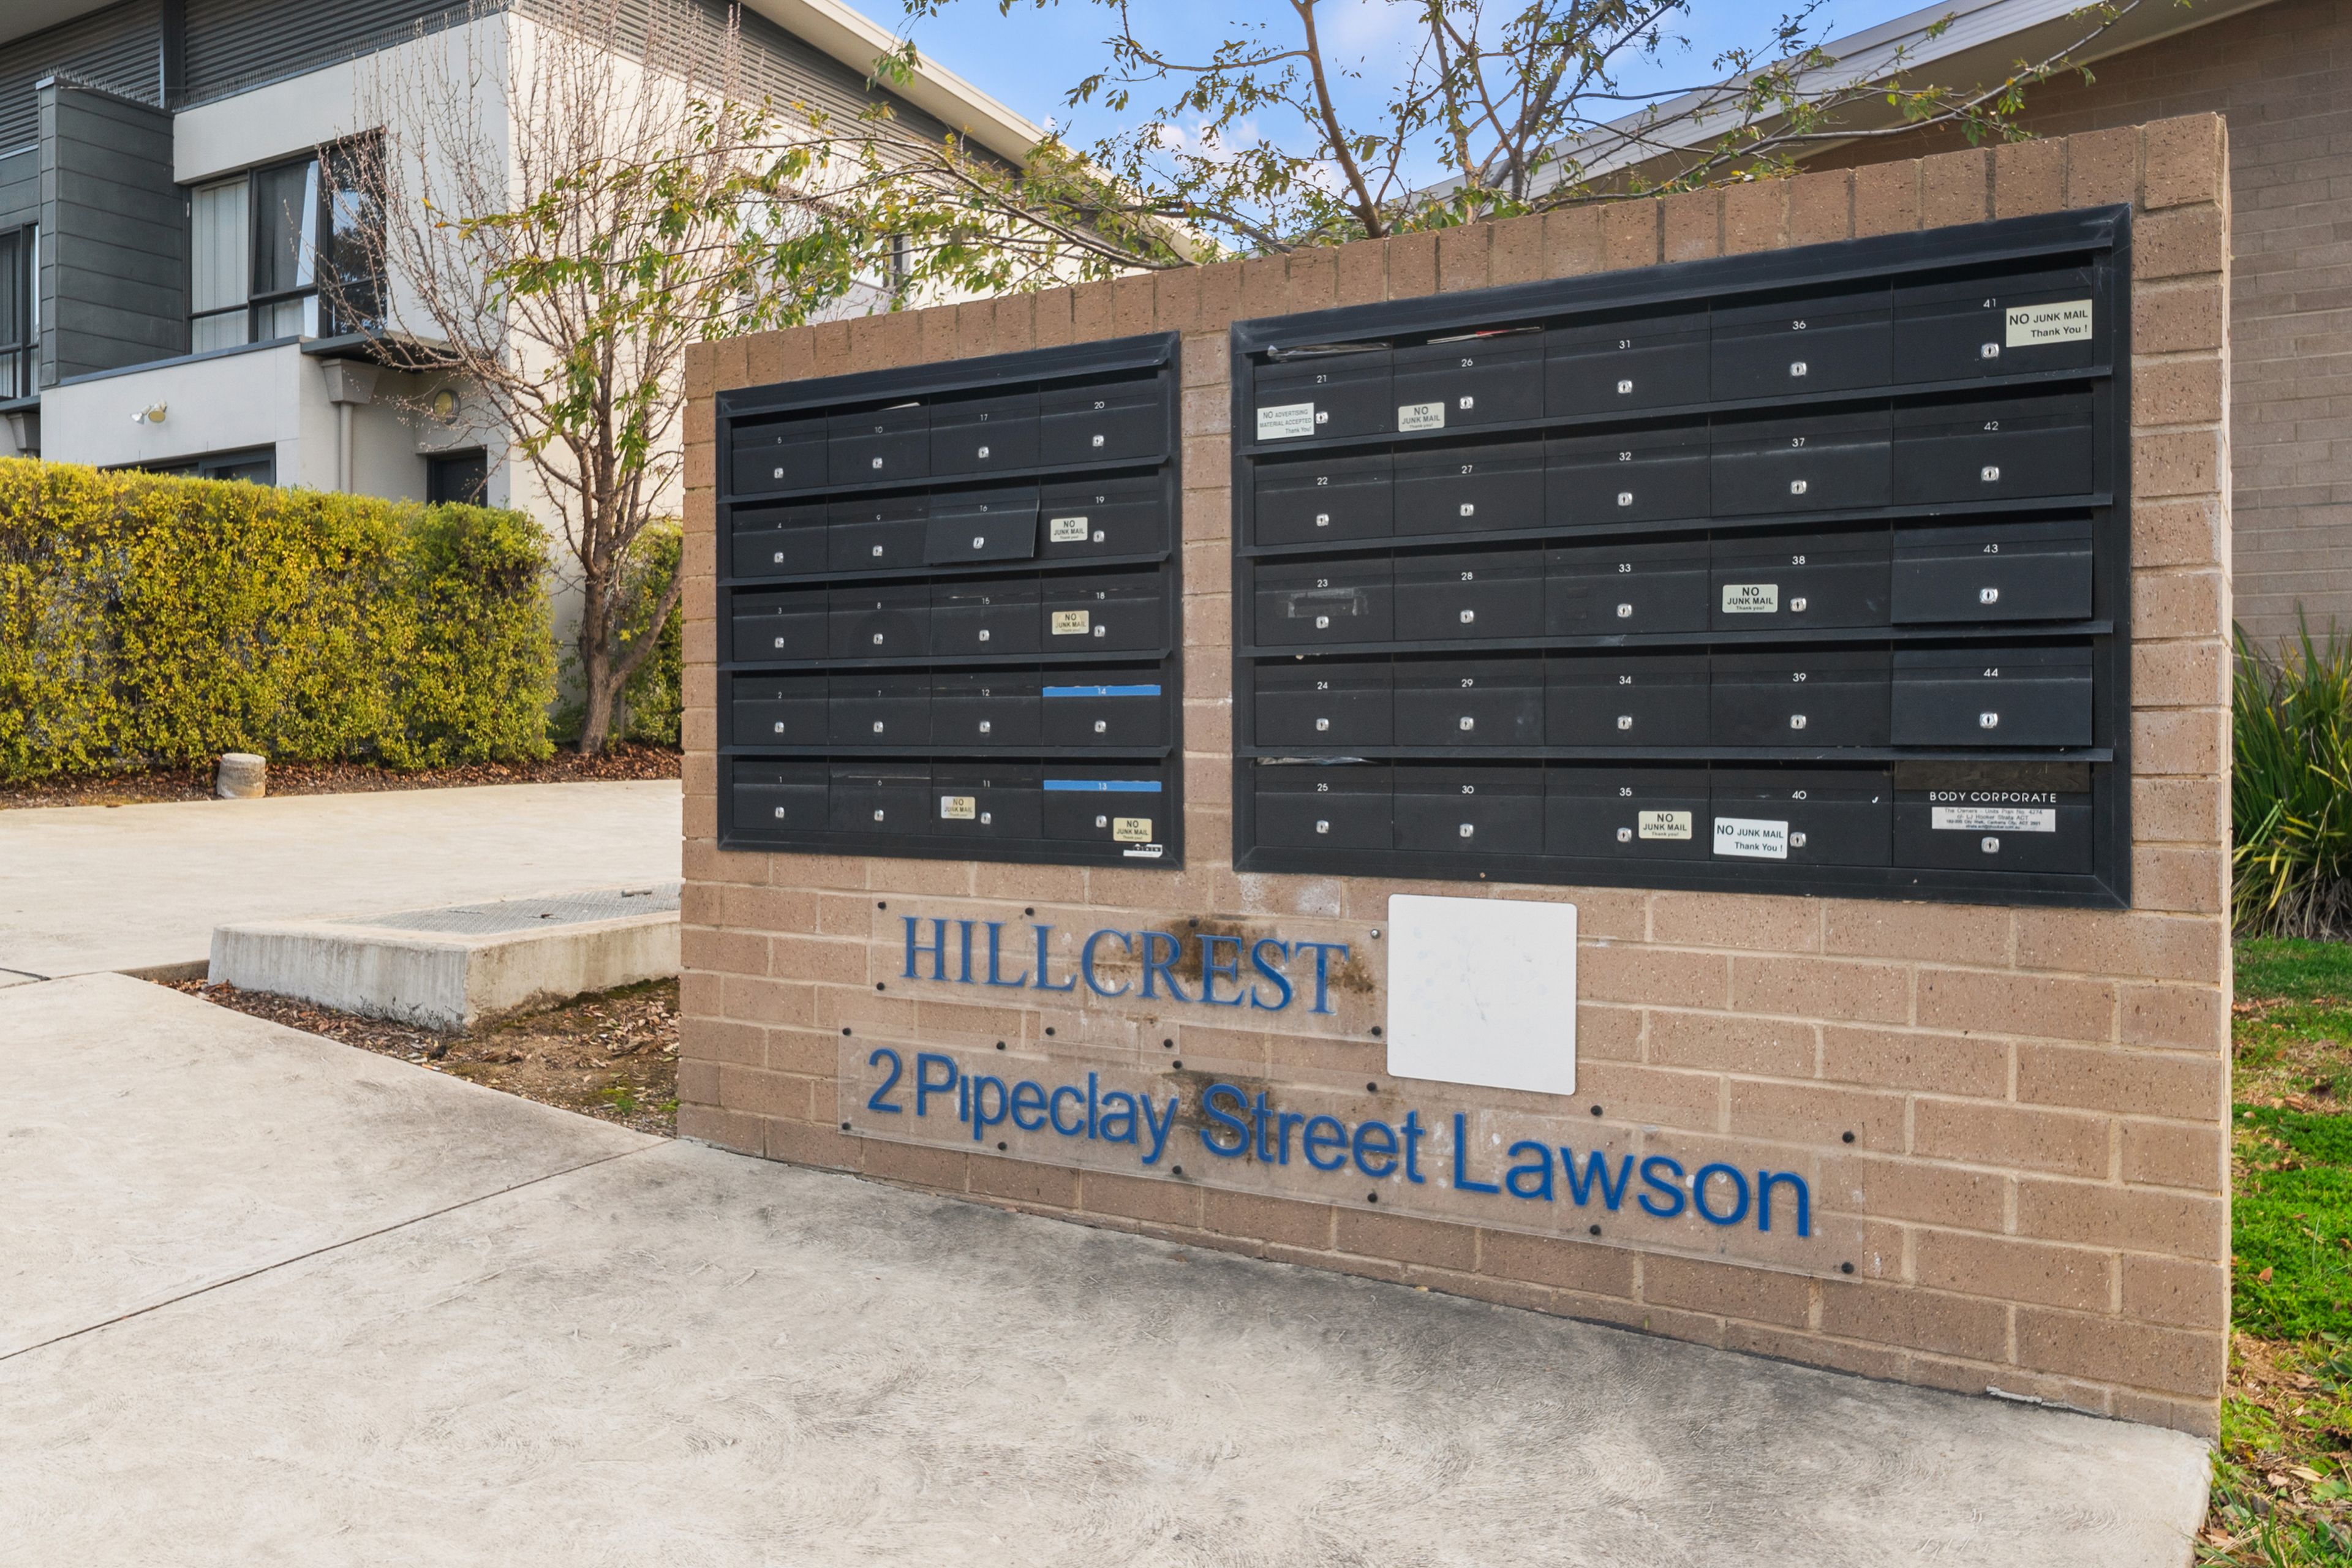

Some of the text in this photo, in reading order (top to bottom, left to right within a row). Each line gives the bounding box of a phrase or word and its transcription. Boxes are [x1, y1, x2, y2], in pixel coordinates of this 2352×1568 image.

[1983, 298, 1996, 308] 41
[2010, 310, 2087, 325] NO JUNK MAIL
[1792, 320, 1806, 330] 36
[2031, 328, 2060, 337] Thank
[1619, 339, 1630, 349] 31
[1461, 358, 1473, 368] 26
[1316, 374, 1327, 383] 21
[1094, 401, 1105, 409] 20
[1275, 409, 1308, 418] ADVERTISING
[1414, 407, 1428, 415] NO
[1984, 421, 1999, 431] 42
[1792, 437, 1805, 447] 37
[1619, 451, 1632, 461] 32
[1461, 465, 1472, 474] 27
[1317, 477, 1328, 486] 22
[1983, 544, 1999, 553] 43
[1792, 555, 1806, 565] 38
[1618, 564, 1631, 573] 33
[1461, 571, 1473, 581] 28
[1317, 579, 1329, 588] 23
[1743, 587, 1759, 596] NO
[1983, 668, 1999, 677] 44
[1619, 676, 1632, 685] 34
[1793, 673, 1806, 682] 39
[1317, 681, 1328, 690] 24
[1461, 679, 1474, 688] 29
[1099, 783, 1107, 791] 13
[1317, 783, 1329, 792] 25
[1461, 785, 1474, 794] 30
[1619, 787, 1632, 797] 35
[1792, 790, 1807, 800] 40
[1929, 791, 2057, 803] BODY CORPORATE
[1657, 813, 1673, 822] NO
[1717, 825, 1734, 835] NO
[1735, 842, 1759, 850] Thank
[899, 915, 1349, 1016] HILLCREST
[867, 1047, 1811, 1238] 2 Pipeclay Street Lawson
